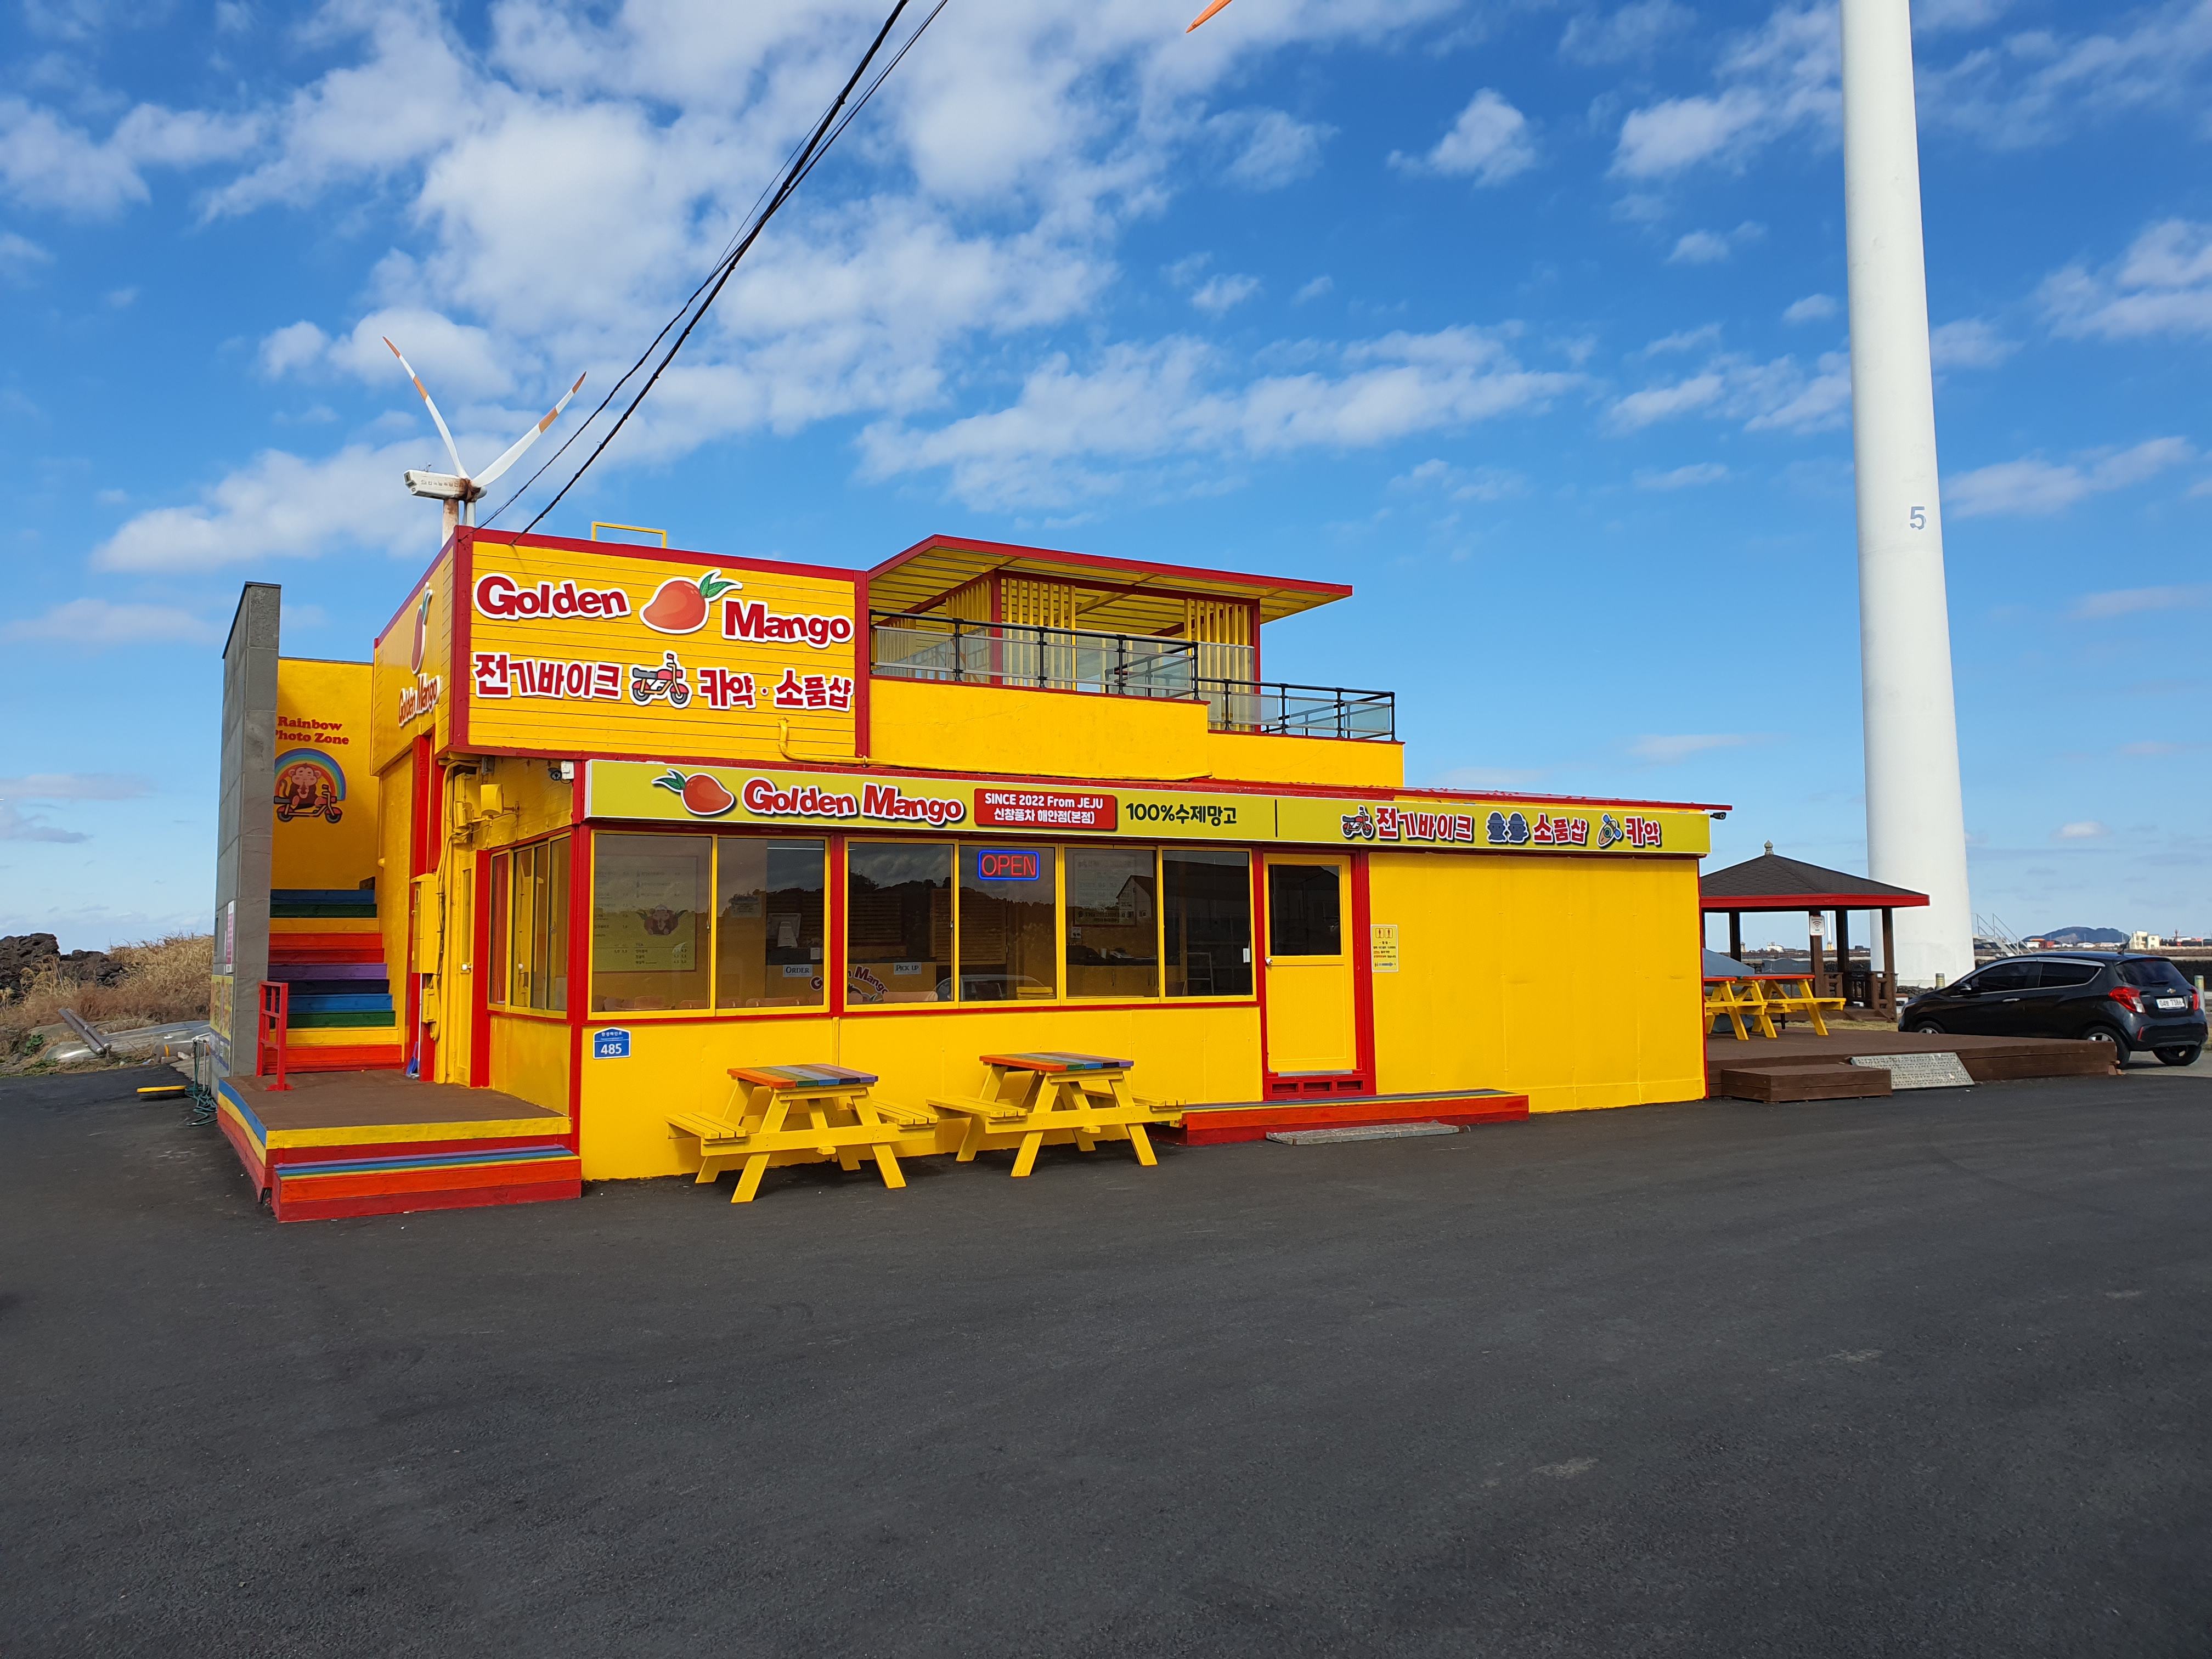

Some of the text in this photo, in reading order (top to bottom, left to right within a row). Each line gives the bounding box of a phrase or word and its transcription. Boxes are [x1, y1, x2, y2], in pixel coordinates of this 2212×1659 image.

[1909, 506, 1927, 530] 5
[475, 573, 853, 647] Golden Mango
[417, 674, 439, 712] Mango
[475, 652, 621, 698] 전기바이크
[697, 668, 755, 709] 카약
[773, 669, 853, 711] 소품샵
[278, 716, 342, 731] Rainbow
[314, 732, 350, 745] Zone
[743, 777, 964, 824] Golden Mango
[985, 793, 1104, 809] SINCE 2022 From JEJU
[994, 808, 1095, 825] 신창풍차 해안점(본점)
[1126, 803, 1237, 827] 100%수제망고
[1375, 806, 1661, 845] 전기바이크 소품샵 카약
[981, 855, 1036, 877] OPEN
[600, 1043, 622, 1054] 485
